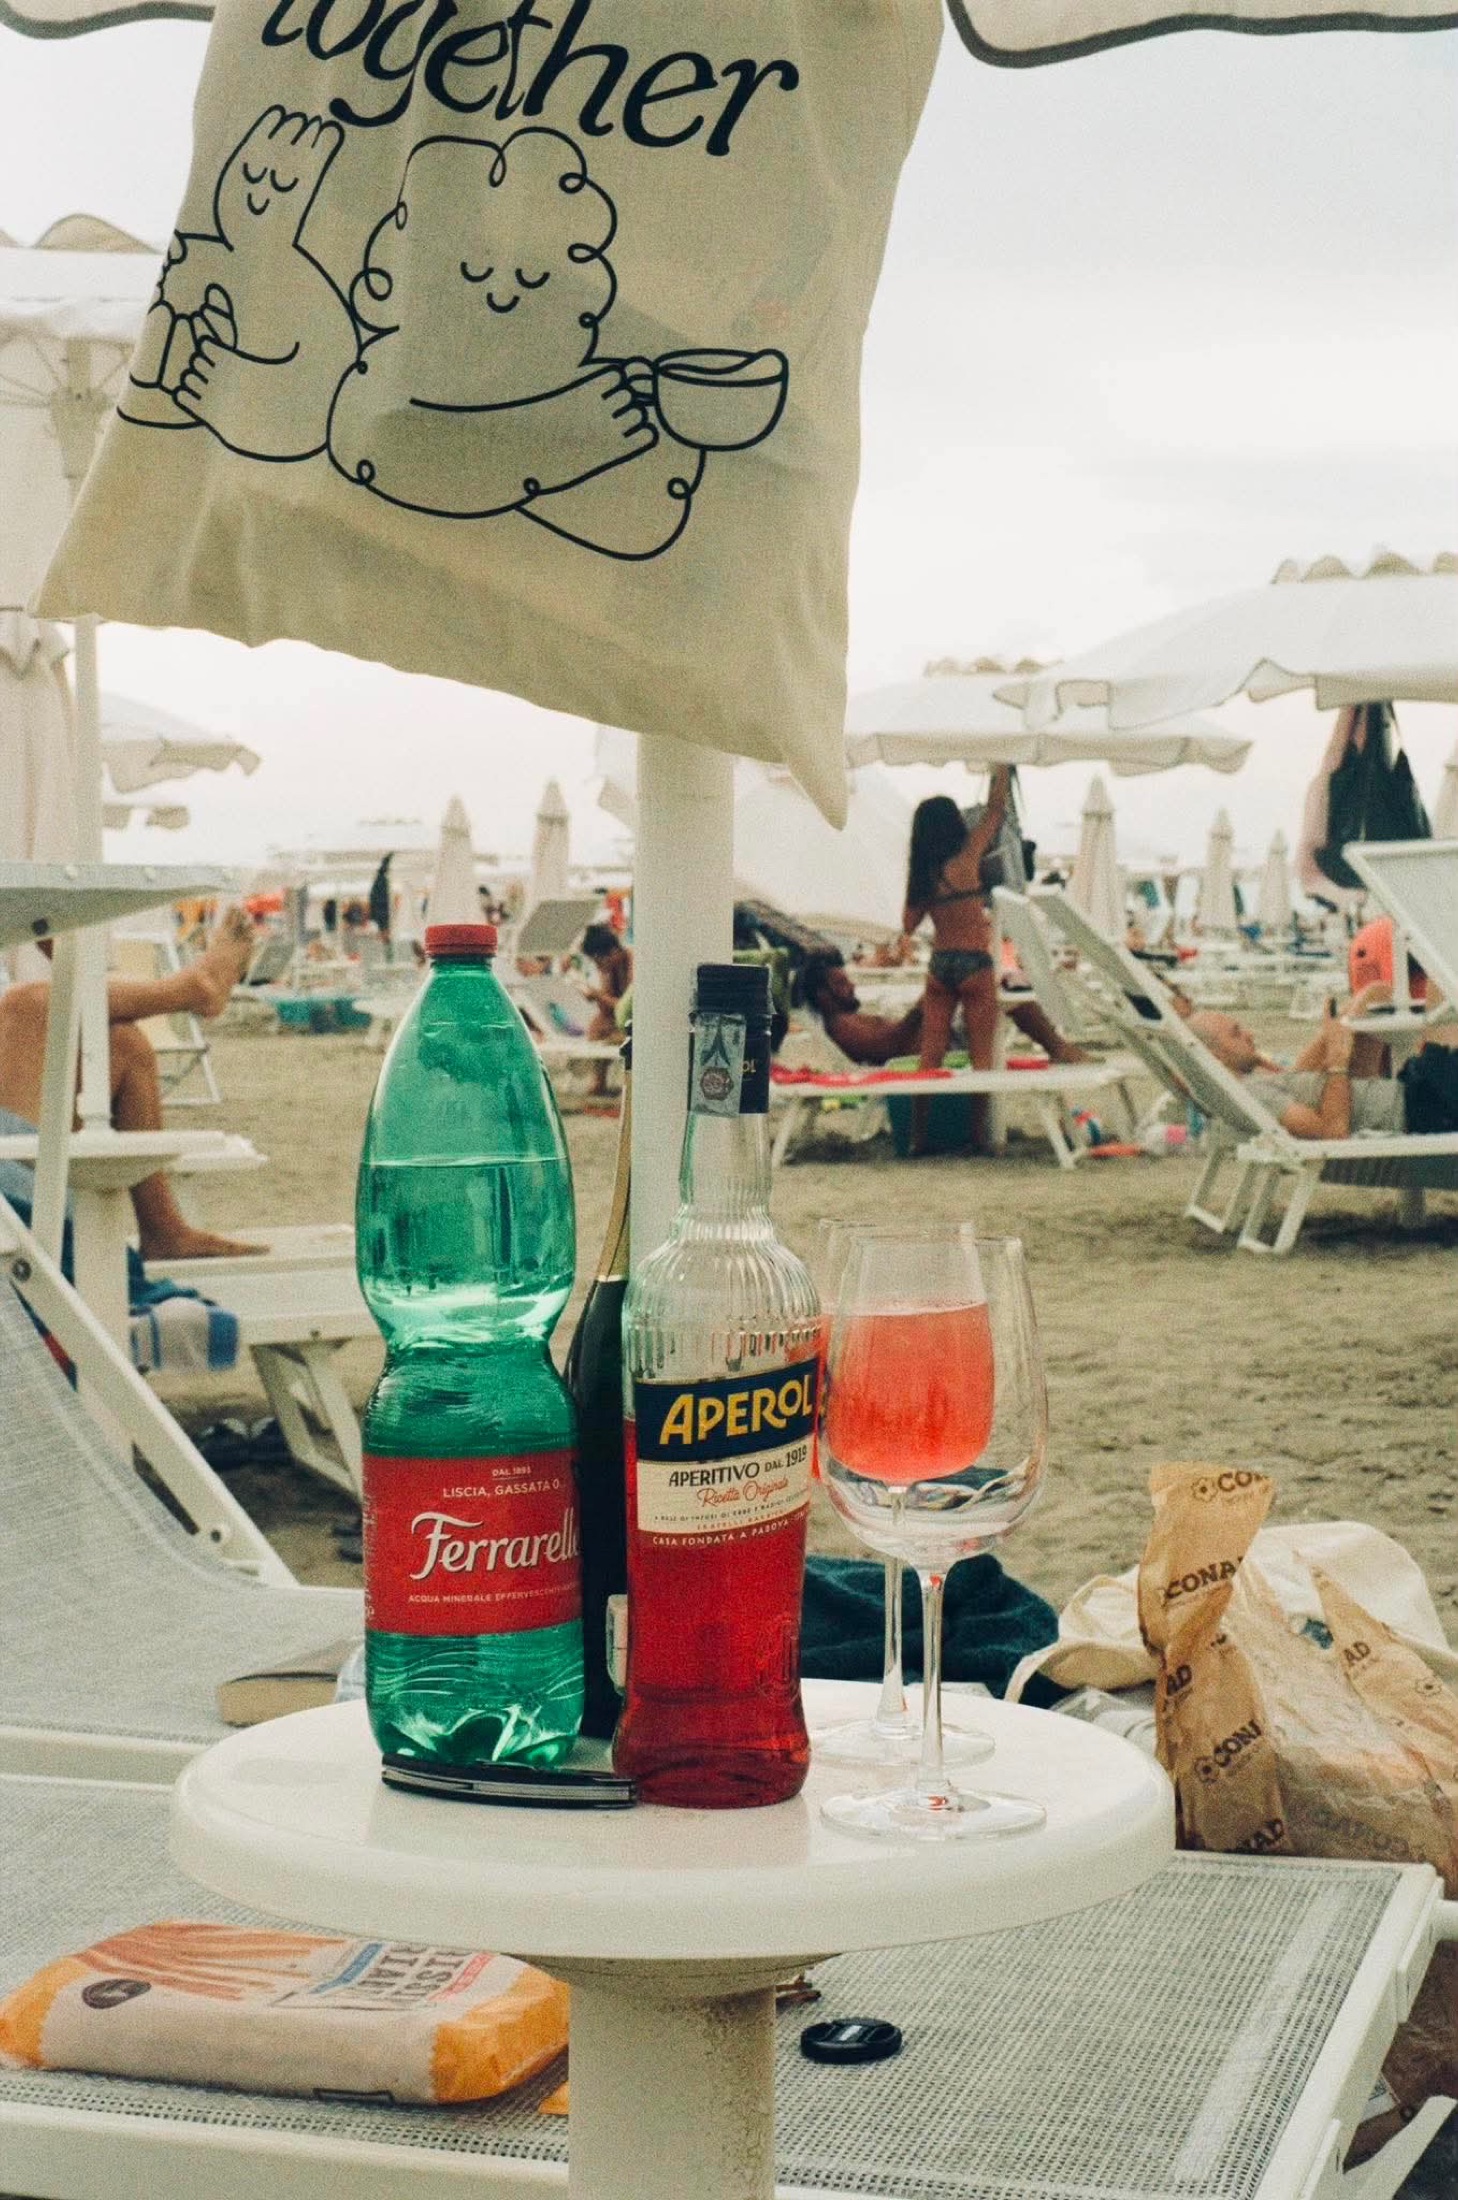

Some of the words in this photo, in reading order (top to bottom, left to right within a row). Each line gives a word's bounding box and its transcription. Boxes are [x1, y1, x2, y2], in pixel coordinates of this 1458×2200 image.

[658, 1374, 813, 1445] APEROL
[492, 1468, 512, 1478] DAL
[669, 1462, 760, 1487] APERITIVO
[764, 1460, 784, 1473] DAL
[786, 1445, 807, 1468] 1919
[443, 1487, 491, 1498] LISCIA,
[495, 1482, 551, 1496] GASSATA
[697, 1487, 741, 1507] Ricetta
[653, 1536, 679, 1546] CASA
[682, 1533, 735, 1546] FONDATA
[751, 1519, 789, 1536] PADOVA
[1164, 1555, 1243, 1599] CONA
[408, 1594, 441, 1604] ACQUA
[443, 1593, 491, 1603] MINERALE
